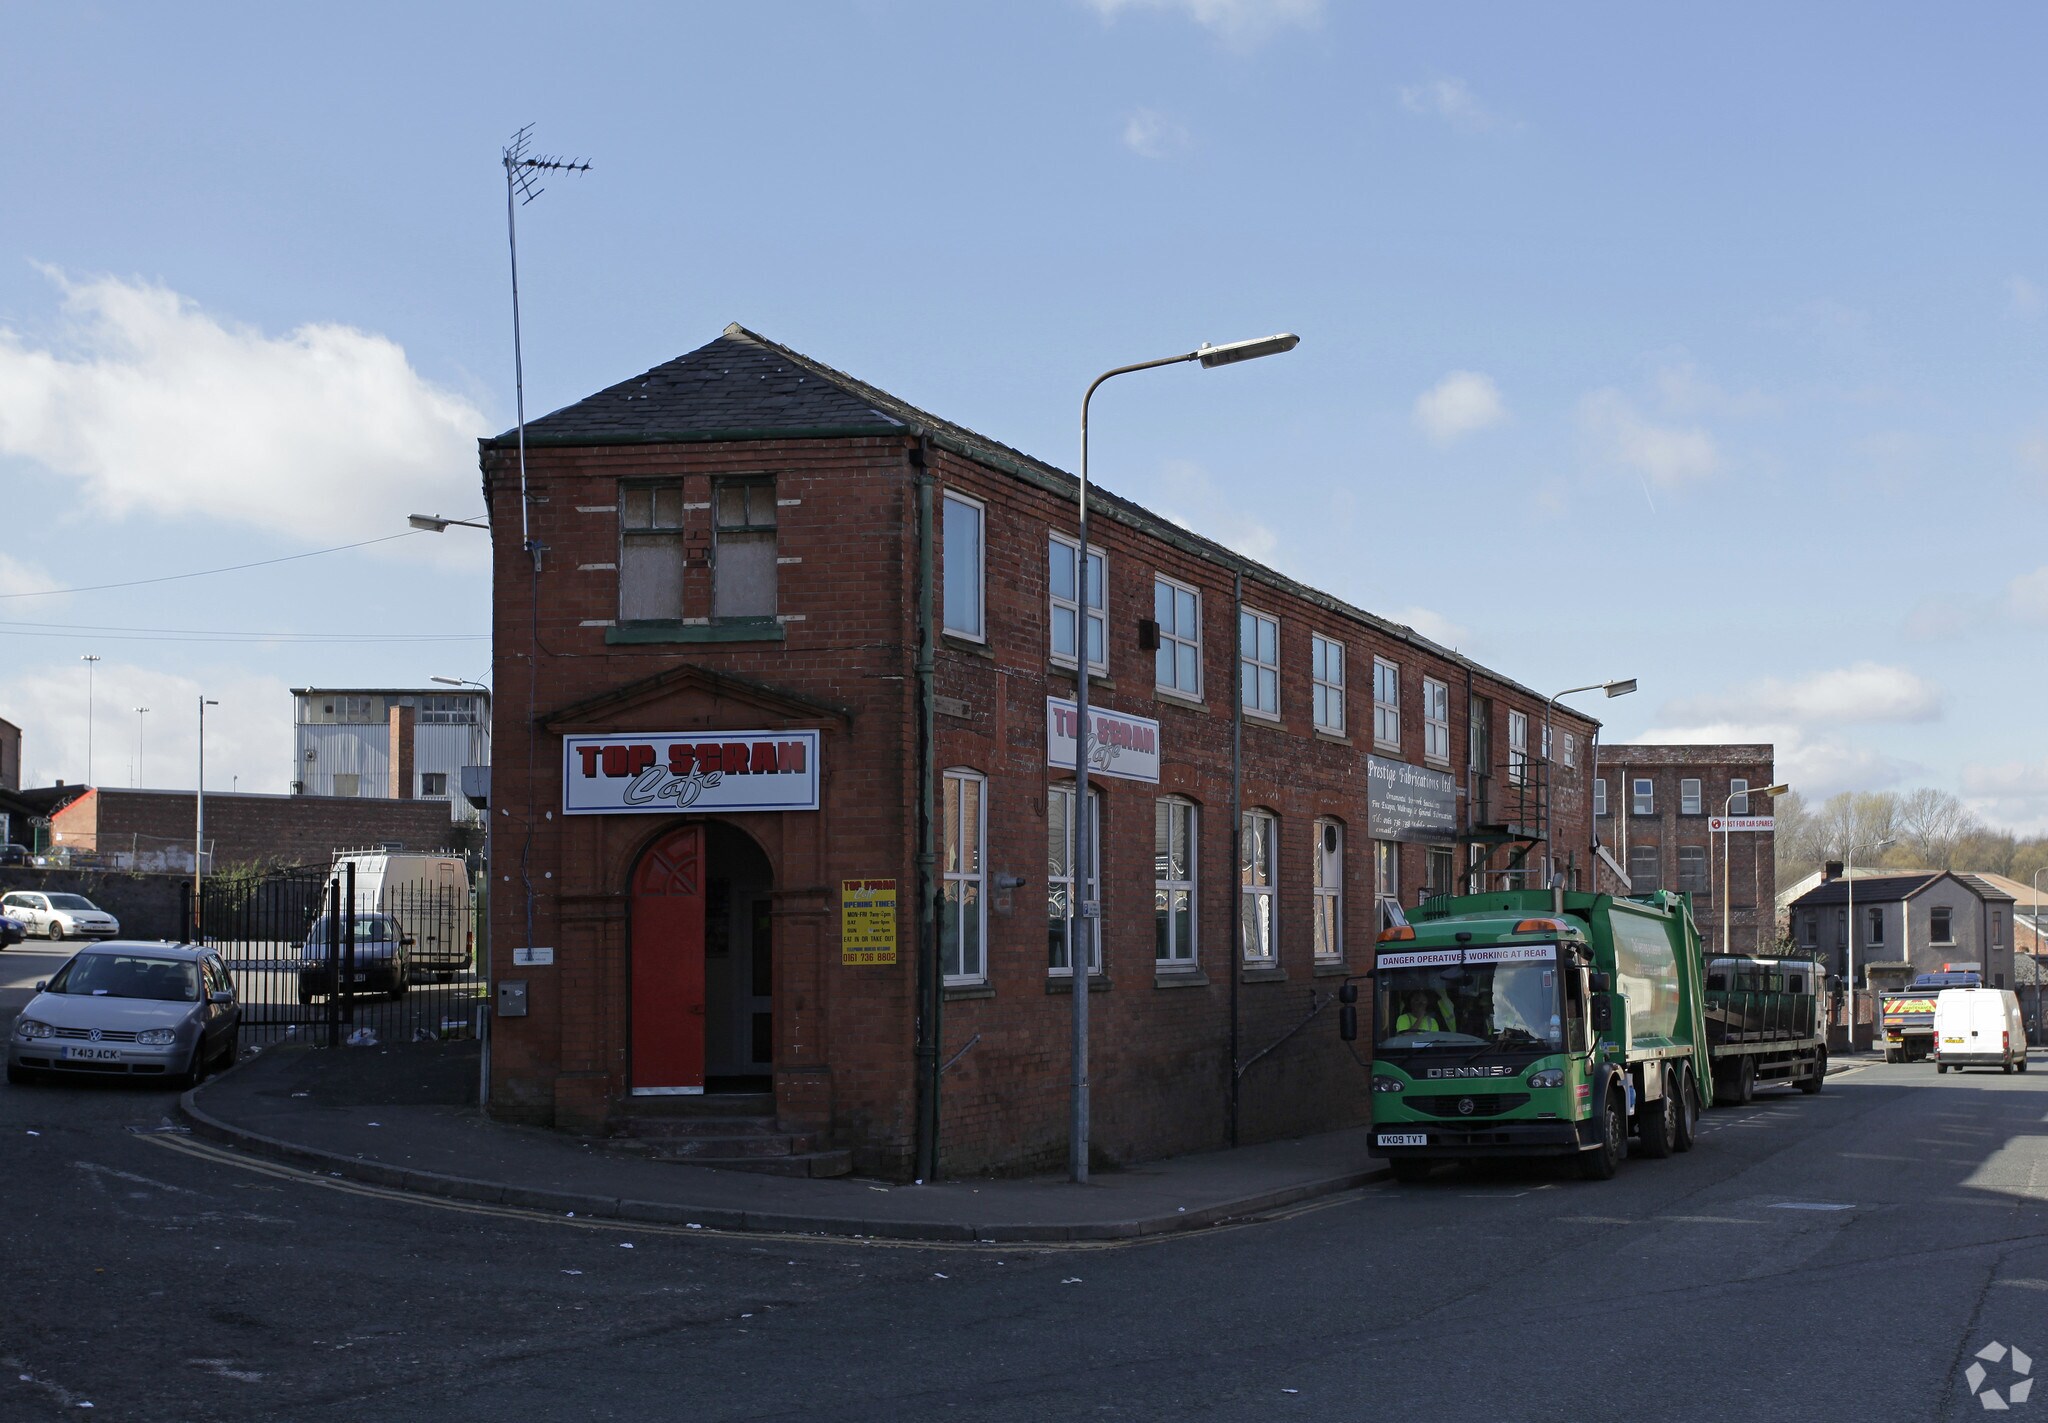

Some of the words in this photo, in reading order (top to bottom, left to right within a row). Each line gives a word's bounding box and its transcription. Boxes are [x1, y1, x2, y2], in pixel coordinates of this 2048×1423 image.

[1097, 717, 1155, 755] SCRAN
[576, 744, 656, 778] TOP
[669, 741, 806, 777] SCRAN
[1368, 760, 1396, 789] Prestige
[1399, 765, 1439, 790] Fabrications
[623, 759, 723, 808] Cafe
[843, 953, 857, 962] 0161
[861, 953, 874, 962] 736
[877, 952, 896, 962] 8802
[1383, 955, 1415, 965] DANGER
[1417, 953, 1466, 963] OPERATIVES
[1469, 951, 1508, 960] WORKING
[1511, 950, 1521, 958] AT
[1524, 949, 1547, 957] REAR
[71, 1048, 94, 1058] T413
[97, 1049, 117, 1059] ACK
[1427, 1066, 1503, 1079] DENNIS
[1381, 1136, 1404, 1144] VK09
[1406, 1135, 1423, 1144] TVT
